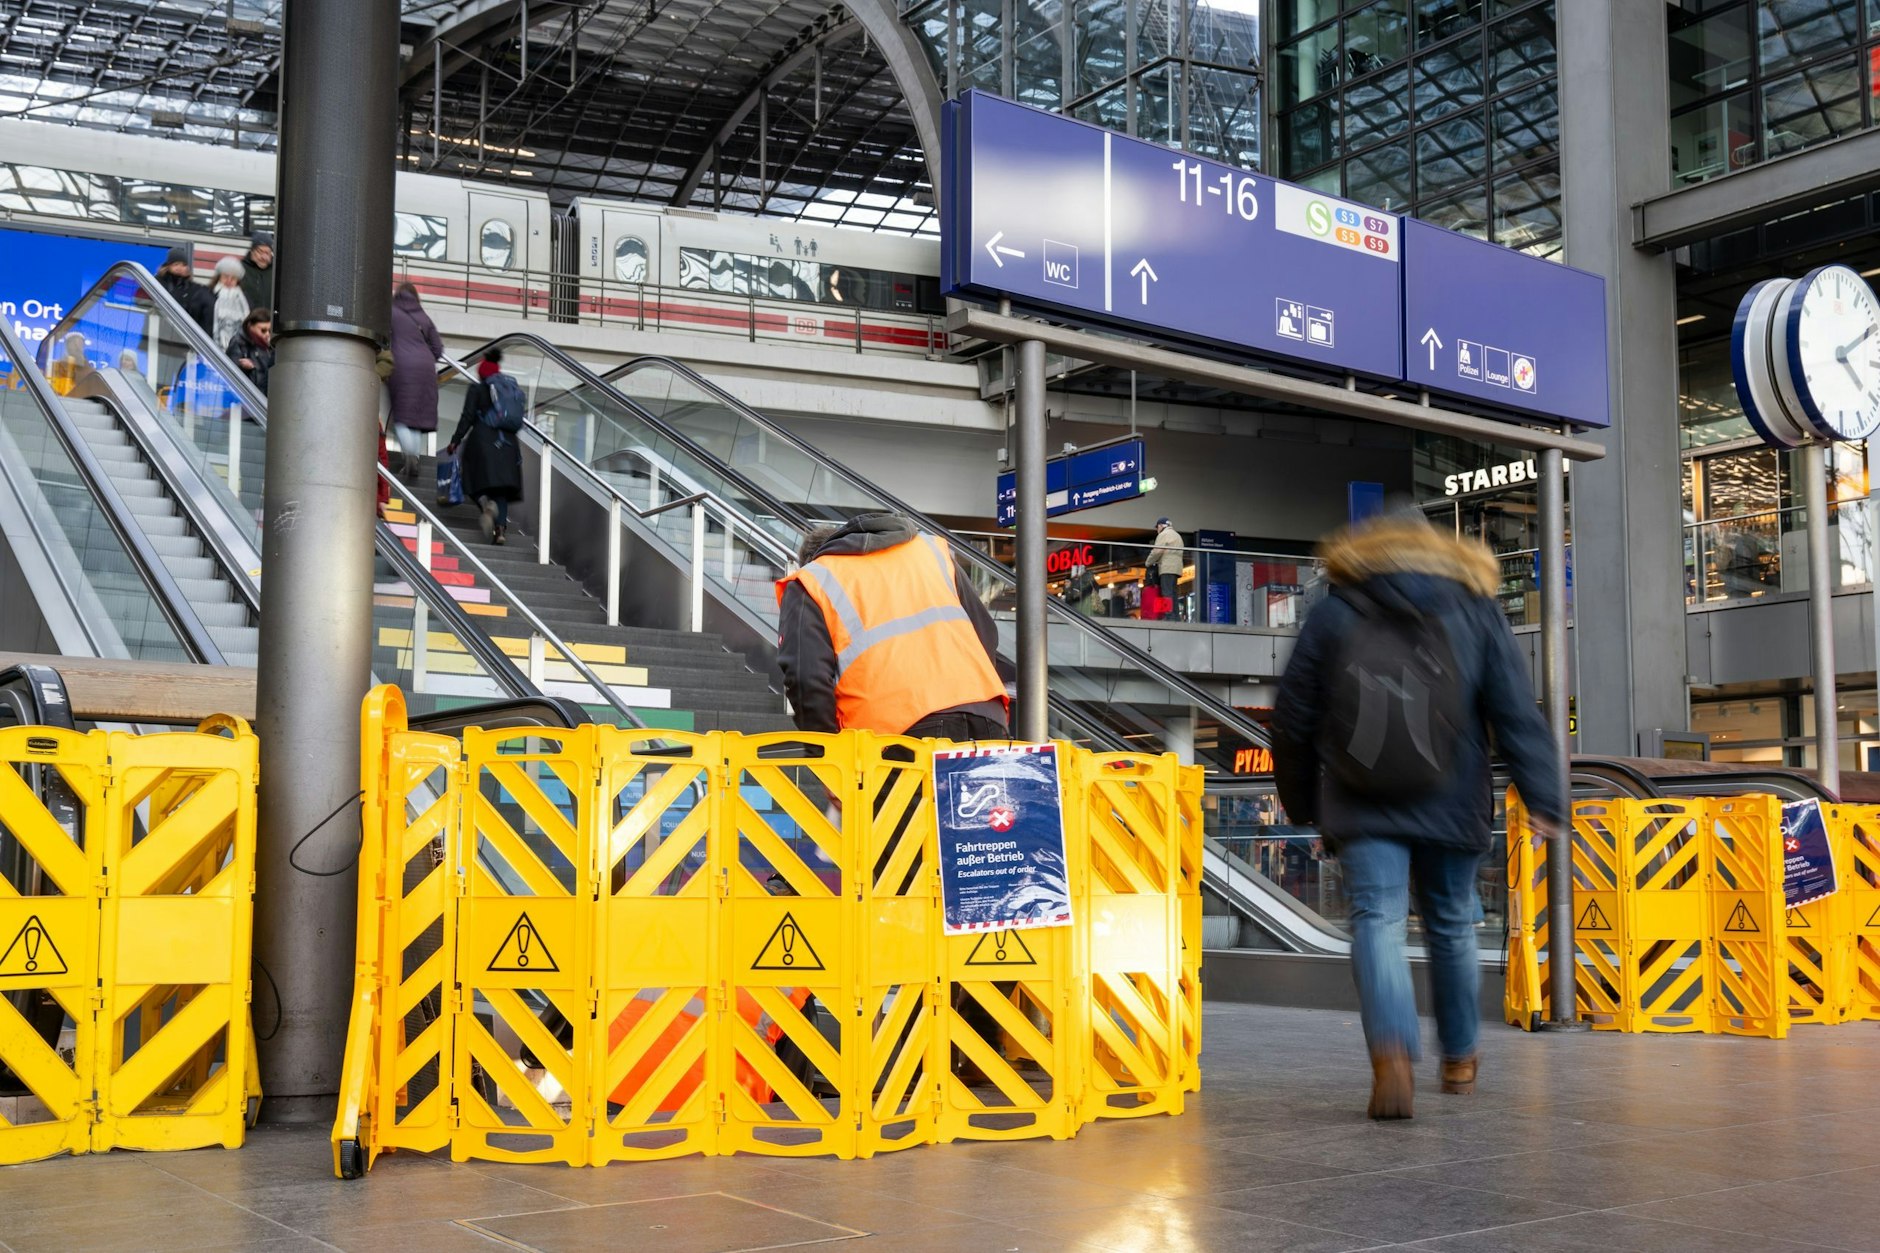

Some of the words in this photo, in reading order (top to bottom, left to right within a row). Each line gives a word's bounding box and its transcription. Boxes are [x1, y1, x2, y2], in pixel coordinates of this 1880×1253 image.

[1172, 158, 1259, 221] 11-16
[1340, 209, 1356, 225] S3
[1368, 218, 1384, 232] S7
[1340, 229, 1356, 244] S5
[1368, 236, 1385, 252] S9
[1046, 260, 1070, 282] WC
[22, 299, 63, 320] Ort
[797, 319, 815, 332] DB
[1460, 363, 1479, 376] Polizei
[1487, 370, 1509, 385] Lounge
[1444, 458, 1570, 496] STARBU
[956, 841, 1017, 853] Fahrtreppen
[957, 855, 986, 866] außer
[987, 851, 1025, 864] Betrieb
[1787, 861, 1810, 871] Betrieb
[957, 868, 995, 878] Escalators
[995, 868, 1007, 876] out
[1008, 866, 1017, 876] of
